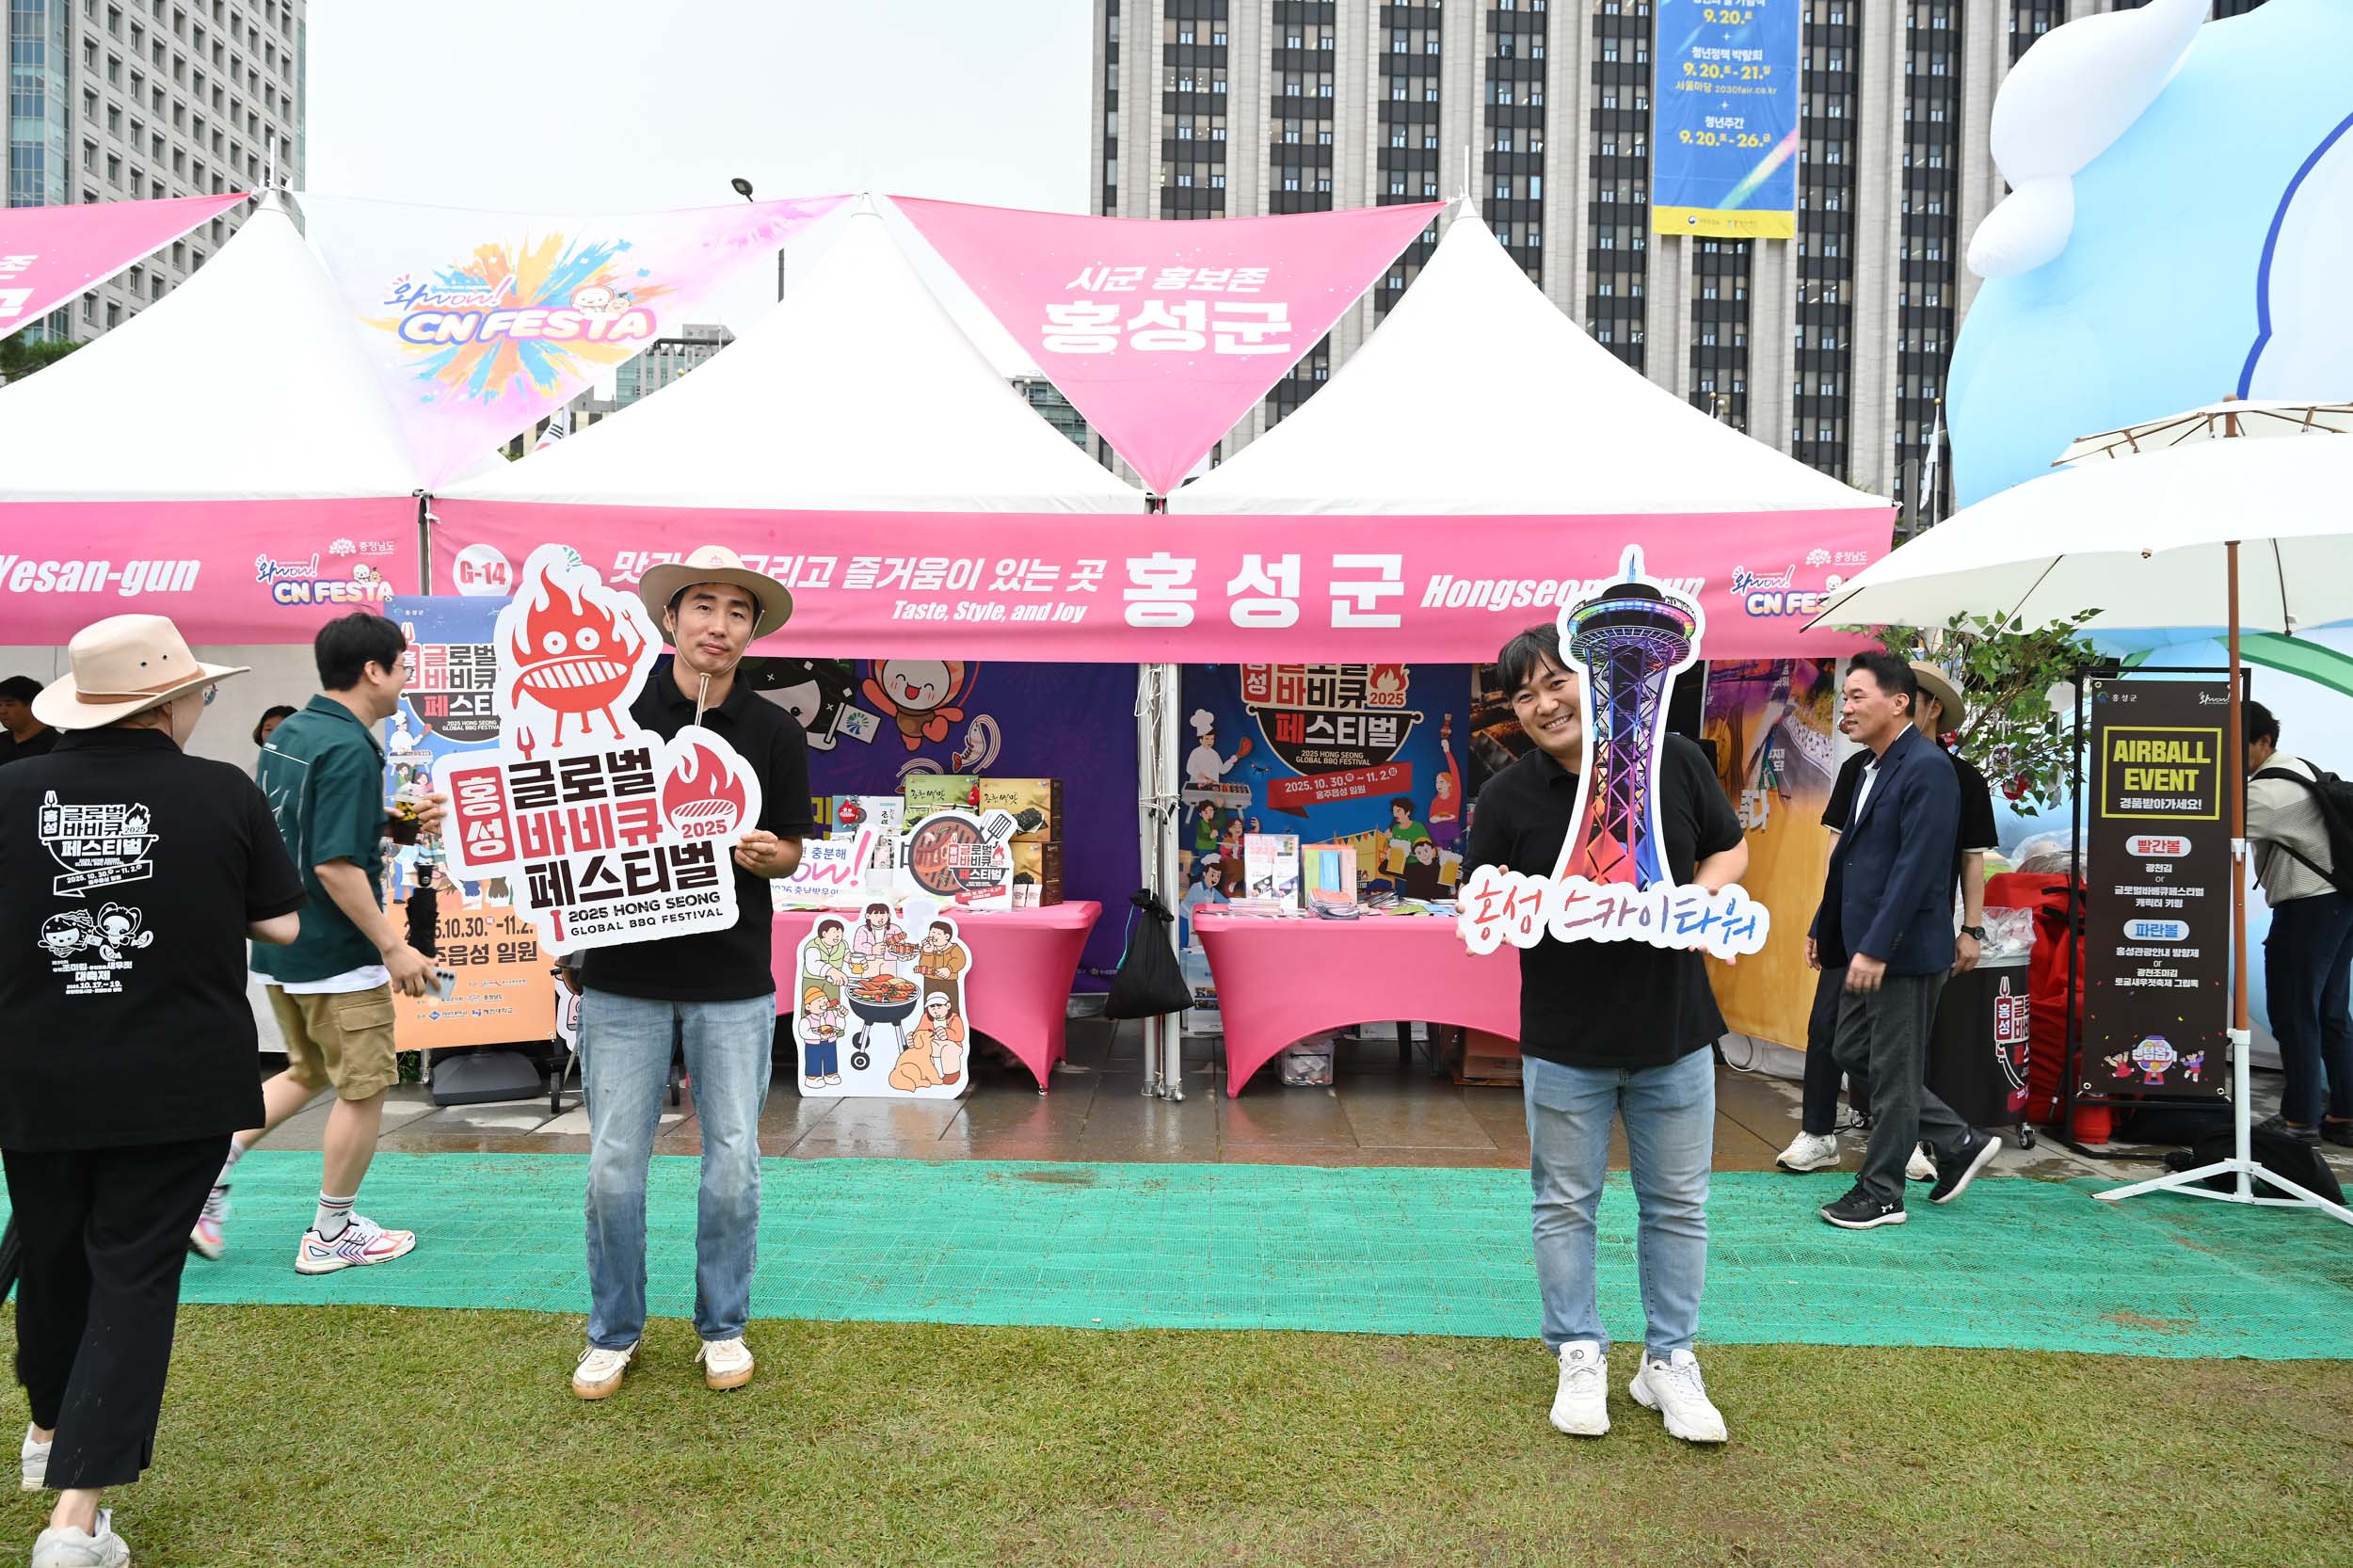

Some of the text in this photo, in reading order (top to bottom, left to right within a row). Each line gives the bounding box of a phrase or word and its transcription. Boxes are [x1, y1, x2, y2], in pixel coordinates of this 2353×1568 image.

[1692, 46, 1762, 61] 청년정책 박람회
[1705, 116, 1744, 129] 청년주간
[1064, 266, 1270, 293] 시군 홍보존
[399, 307, 657, 344] CN FESTA
[1042, 300, 1291, 355] 홍성군
[360, 541, 394, 552] 충청남도
[1834, 551, 1867, 562] 충청남도
[0, 554, 201, 597] Yesan-gun
[459, 560, 505, 586] G-14
[845, 556, 981, 592] 즐거움이
[989, 558, 1061, 592] 있는
[1065, 559, 1108, 593] 곳
[273, 580, 393, 605] CN FESTA
[1746, 591, 1830, 616] CN FES
[892, 600, 1088, 623] Taste, Style, and Joy
[424, 645, 497, 666] 글로벌
[424, 667, 496, 690] 바비큐
[1276, 676, 1367, 709] 바비큐
[1369, 692, 1404, 706] 2025
[424, 695, 498, 717] 페스티
[1275, 712, 1397, 747] 페스티벌
[1296, 756, 1370, 766] GLOBAL BBQ FESTIVAL
[2112, 740, 2212, 763] AIRBALL
[508, 747, 657, 810] 글로벌
[1285, 781, 1313, 792] 2025.
[1314, 778, 1330, 789] 10.
[1366, 772, 1378, 782] 11.
[2124, 768, 2199, 792] EVENT
[1316, 784, 1366, 800] 홍주읍성 일원
[2120, 797, 2202, 809] 경품받아가세요!
[64, 807, 123, 821] 글로벌
[457, 776, 507, 857] 홍성
[63, 822, 122, 837] 바비큐
[517, 798, 664, 859] 바비큐
[681, 819, 728, 839] 2025
[61, 838, 142, 856] 페스티벌
[811, 847, 846, 860] 충분해
[960, 844, 992, 856] 글로벌
[2137, 840, 2180, 854] 빨간볼
[960, 856, 991, 867] 바비큐
[2146, 863, 2172, 873] 광천김
[67, 875, 87, 884] 2025.
[524, 840, 719, 909] 페스티벌
[568, 891, 721, 922] 2025 HONG SEONG
[1473, 878, 1756, 946] 홍성 스카이타워
[570, 907, 724, 936] GLOBAL BBQ FESTIVAL
[2136, 923, 2178, 937] 파란볼
[497, 941, 537, 963] 일원
[1998, 1003, 2010, 1035] 홍성
